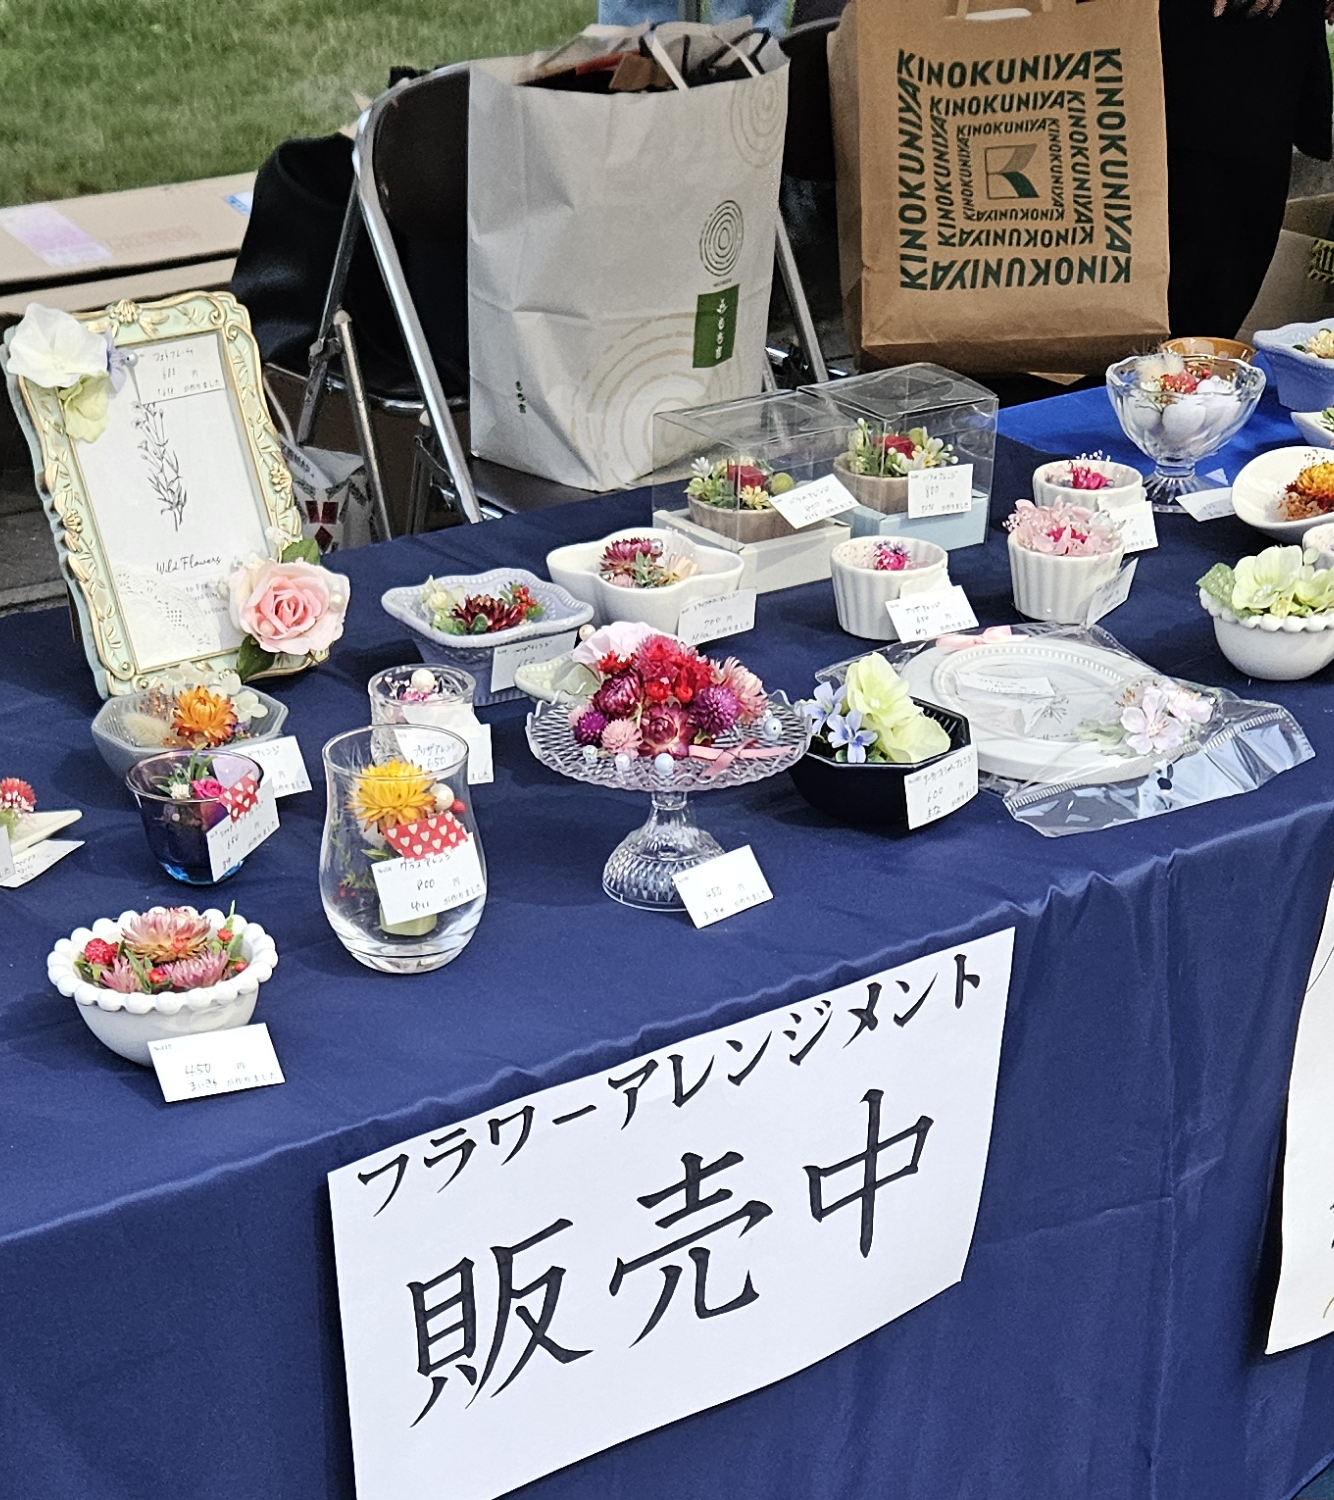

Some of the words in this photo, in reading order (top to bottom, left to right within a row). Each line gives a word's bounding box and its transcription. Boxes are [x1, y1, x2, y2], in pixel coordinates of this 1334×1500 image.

[897, 49, 1092, 88] KINOKUNIYA
[930, 90, 1065, 116] KINOKUNIYA
[957, 118, 1048, 137] KINOKUNIYA
[1047, 118, 1064, 209] KINOKUNIYA
[1066, 90, 1094, 224] KINOKUNIYA
[1094, 48, 1132, 254] KINOKUNIYA
[897, 77, 928, 290] KINOKUNIYA
[930, 114, 957, 247] KINOKUNIYA
[957, 135, 976, 221] KINOKUNIYA
[976, 209, 1064, 222] KINOKUNIYA
[930, 256, 1132, 291] KINOKUNIYA
[959, 226, 1094, 248] KINOKUNIYA
[180, 553, 223, 569] Flowers
[358, 954, 980, 1217] フラワーアレンジメント
[409, 1088, 933, 1428] 販売中
